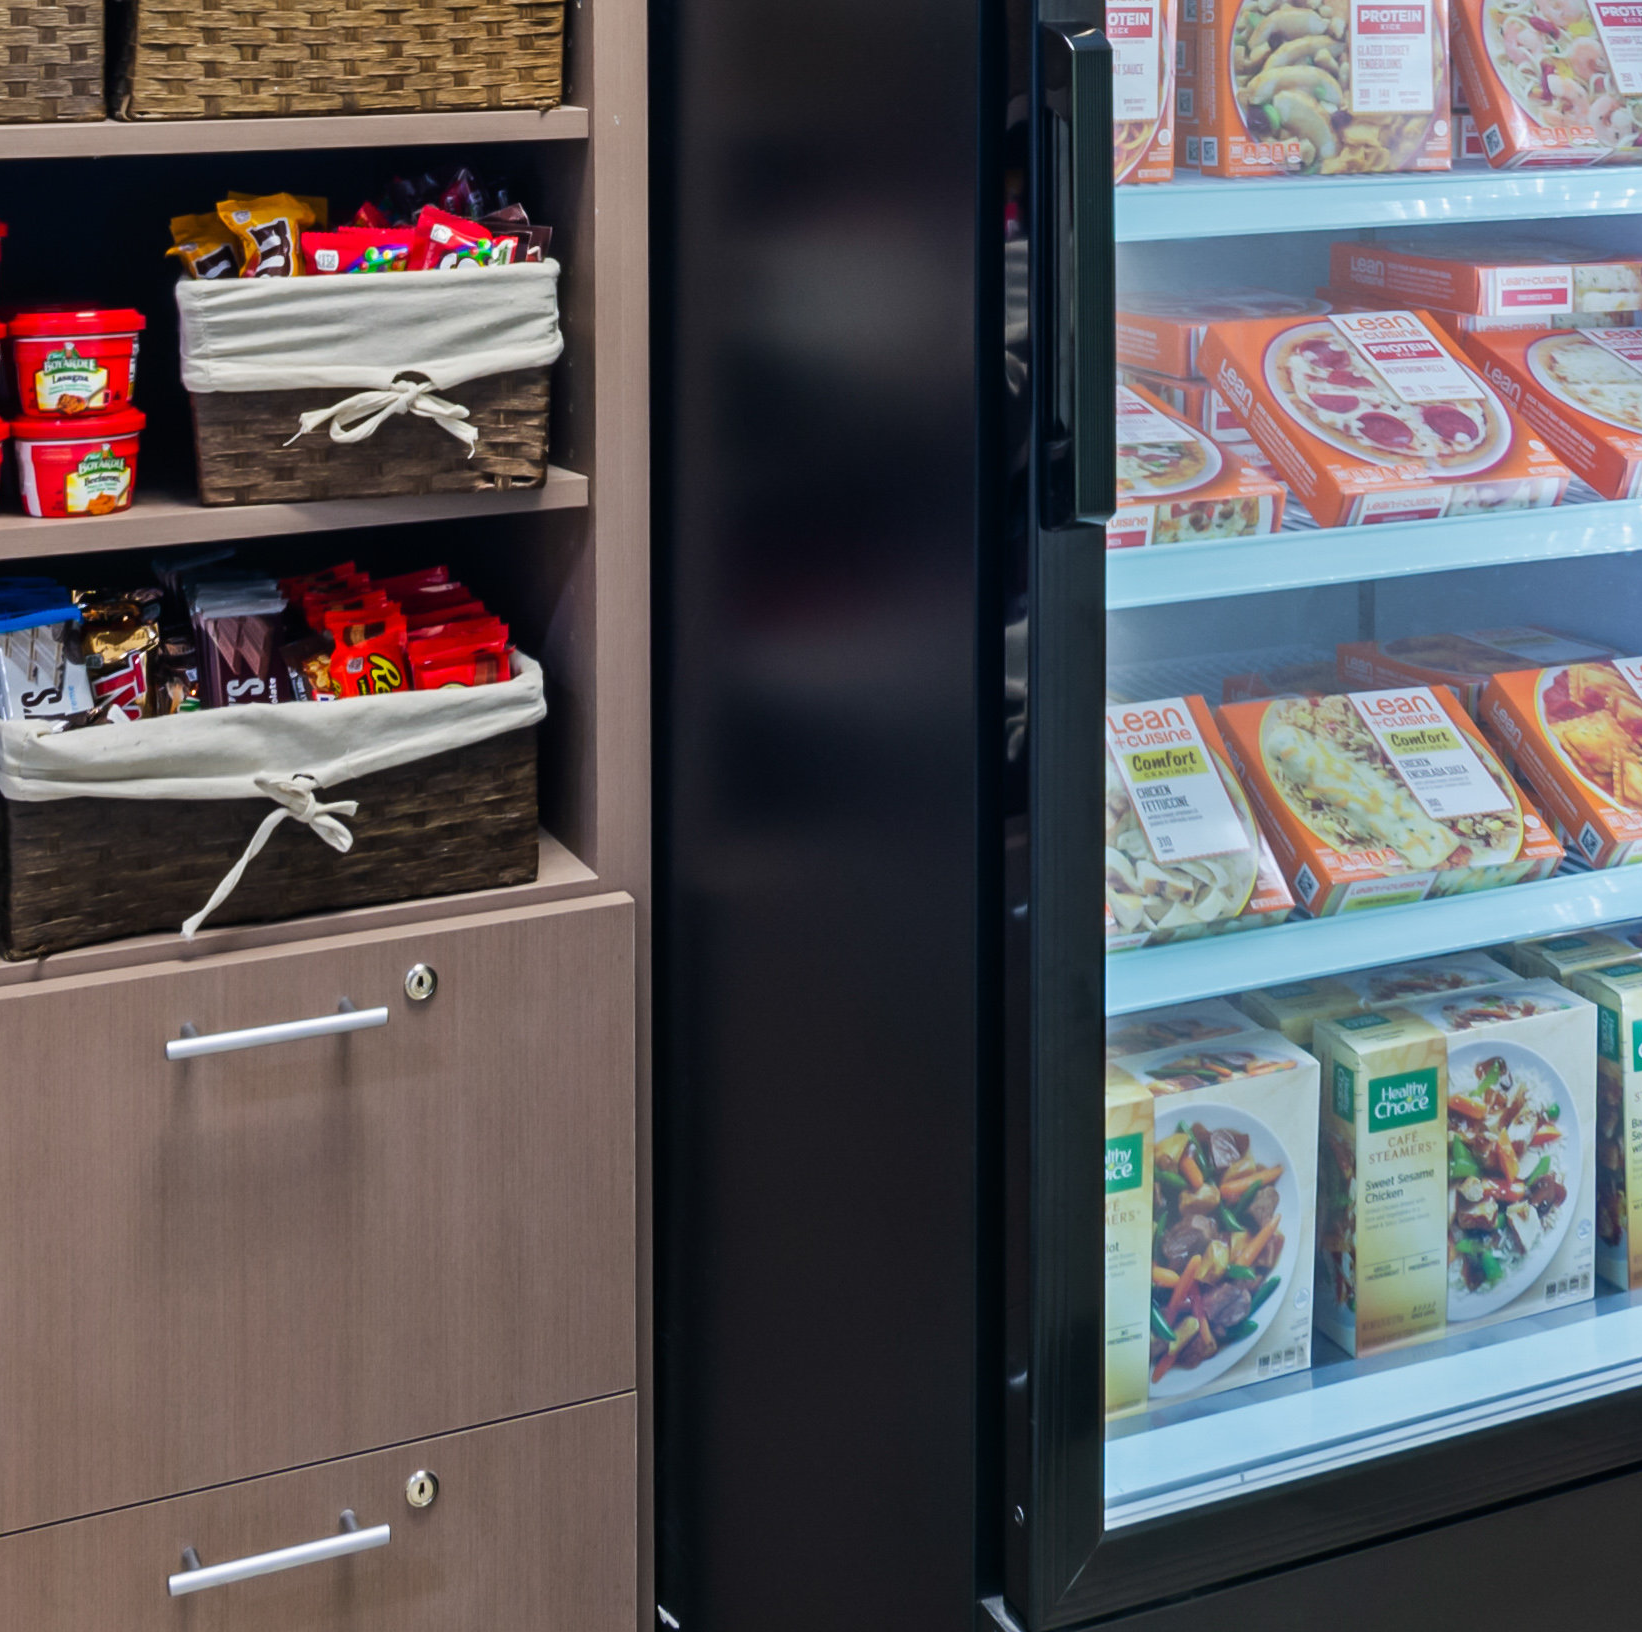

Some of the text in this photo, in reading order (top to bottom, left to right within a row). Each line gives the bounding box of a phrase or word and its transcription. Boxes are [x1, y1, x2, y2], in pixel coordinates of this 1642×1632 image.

[1360, 9, 1422, 24] PROTEIN
[43, 357, 96, 372] BOYARDEE
[52, 374, 89, 385] Lasagna
[1109, 707, 1185, 735] Lean
[1132, 750, 1197, 772] Comfort
[1381, 1082, 1427, 1101] Healthy
[1374, 1095, 1429, 1119] Choice
[1364, 1168, 1435, 1192] Sweet Sesame
[1364, 1188, 1404, 1204] Chicken
